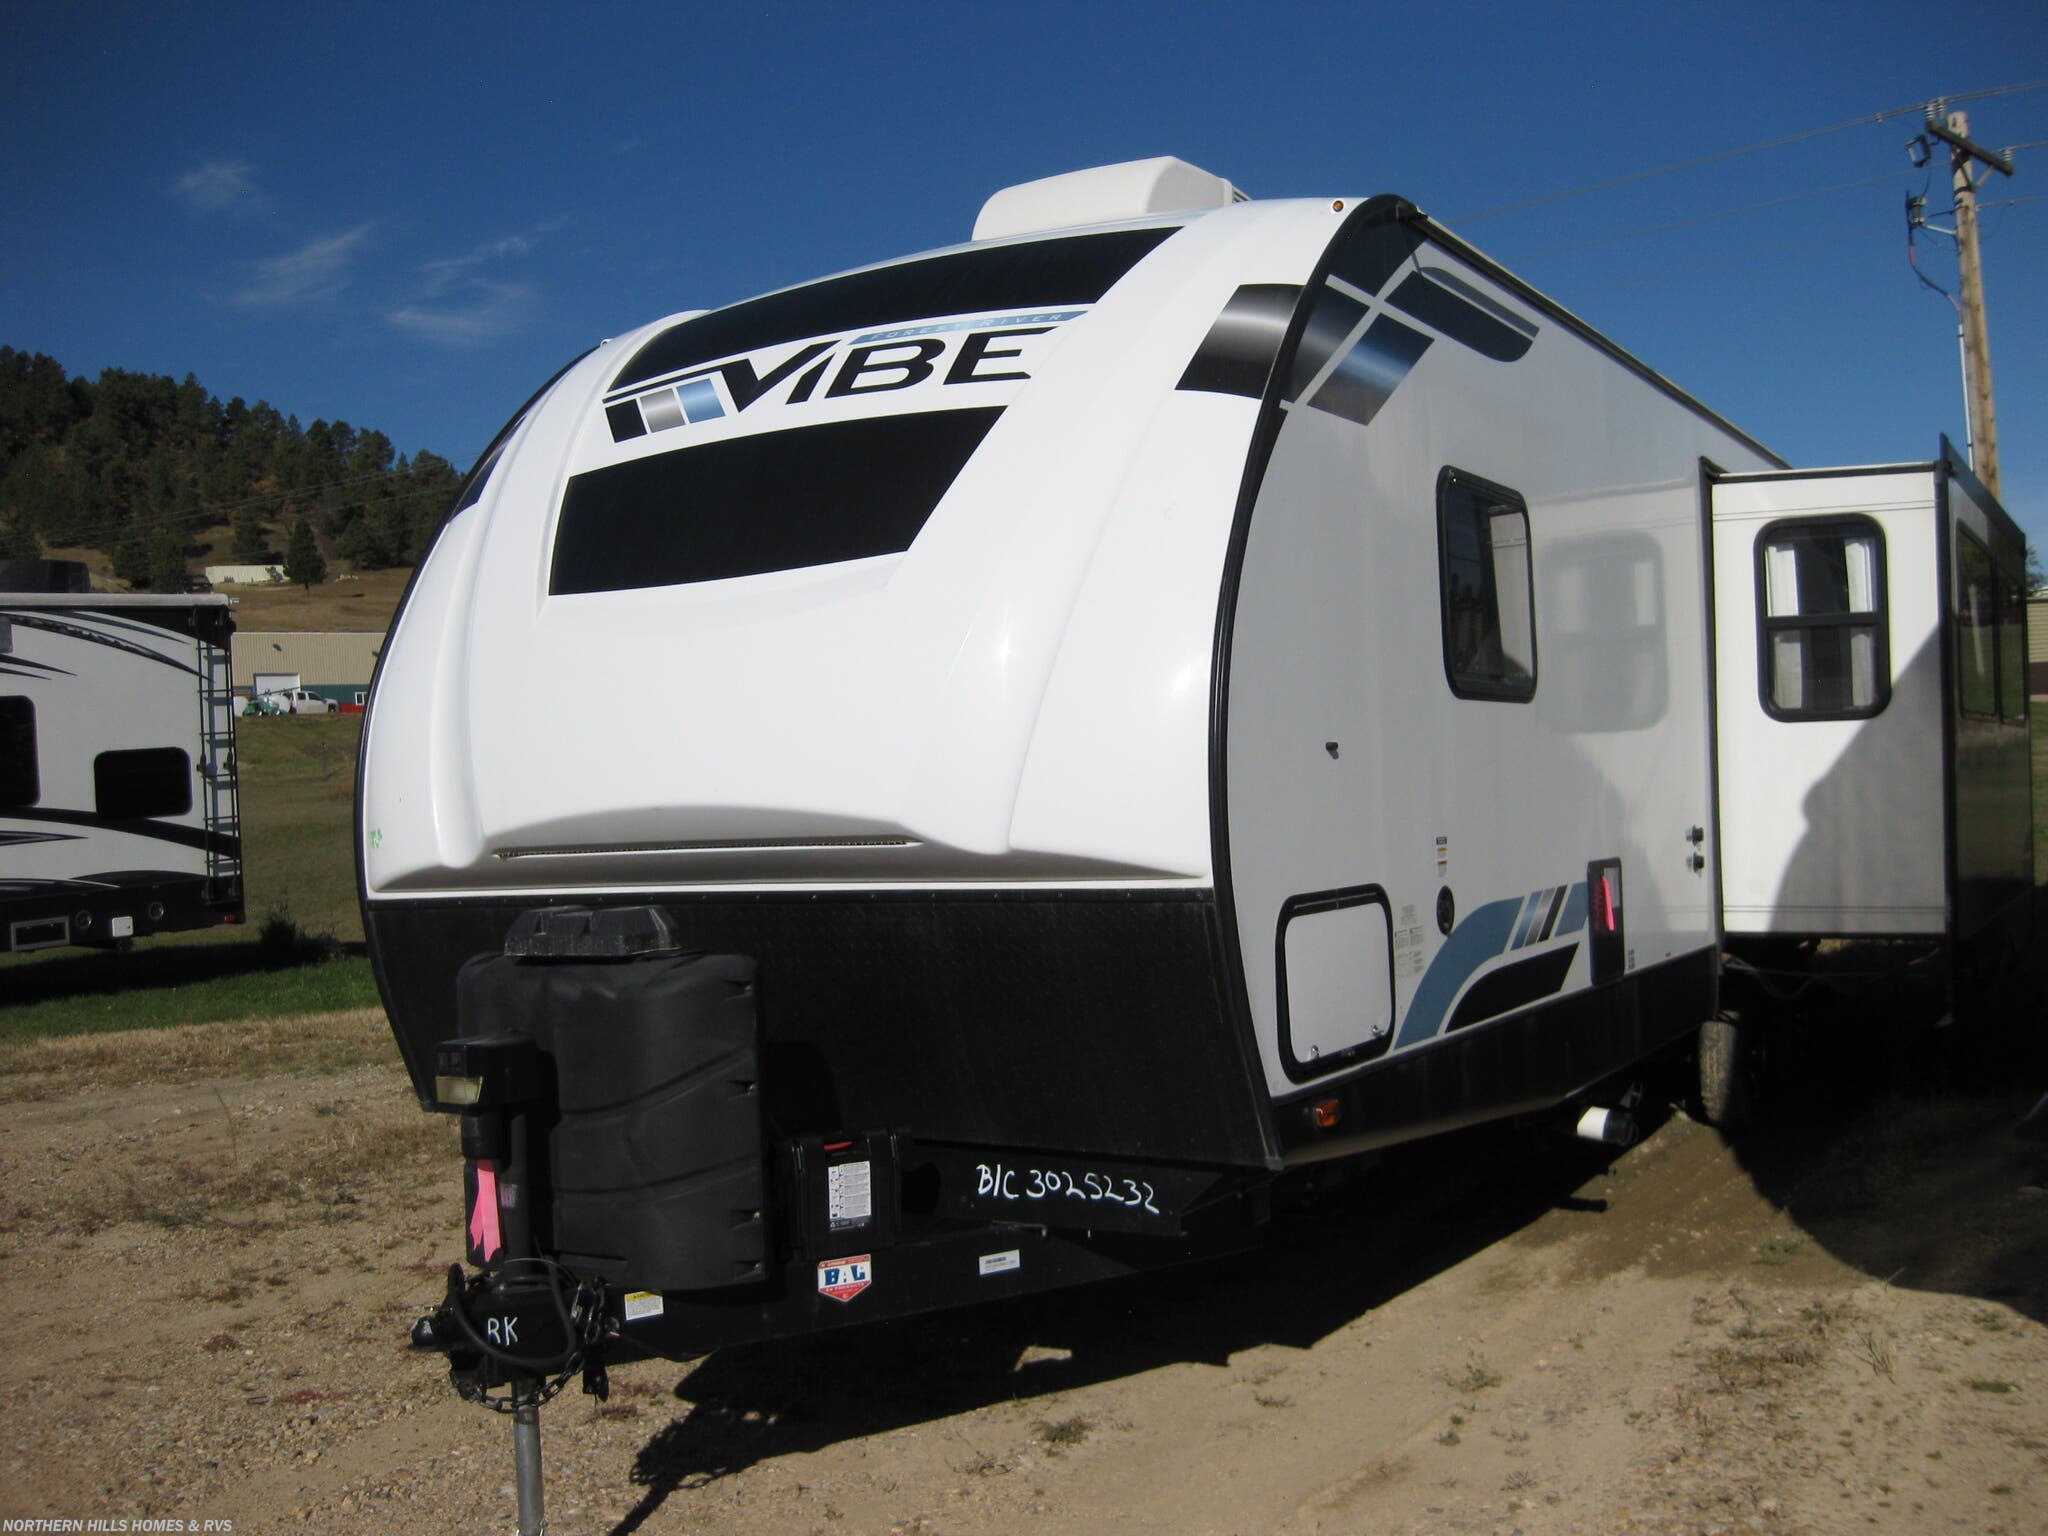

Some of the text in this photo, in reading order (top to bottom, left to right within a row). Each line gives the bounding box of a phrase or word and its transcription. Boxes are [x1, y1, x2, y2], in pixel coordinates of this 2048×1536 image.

[981, 313, 1064, 327] RIVER
[603, 326, 1058, 413] VIBE
[1026, 1170, 1160, 1214] 3025232
[824, 1265, 866, 1286] BAL
[487, 1316, 518, 1346] RK
